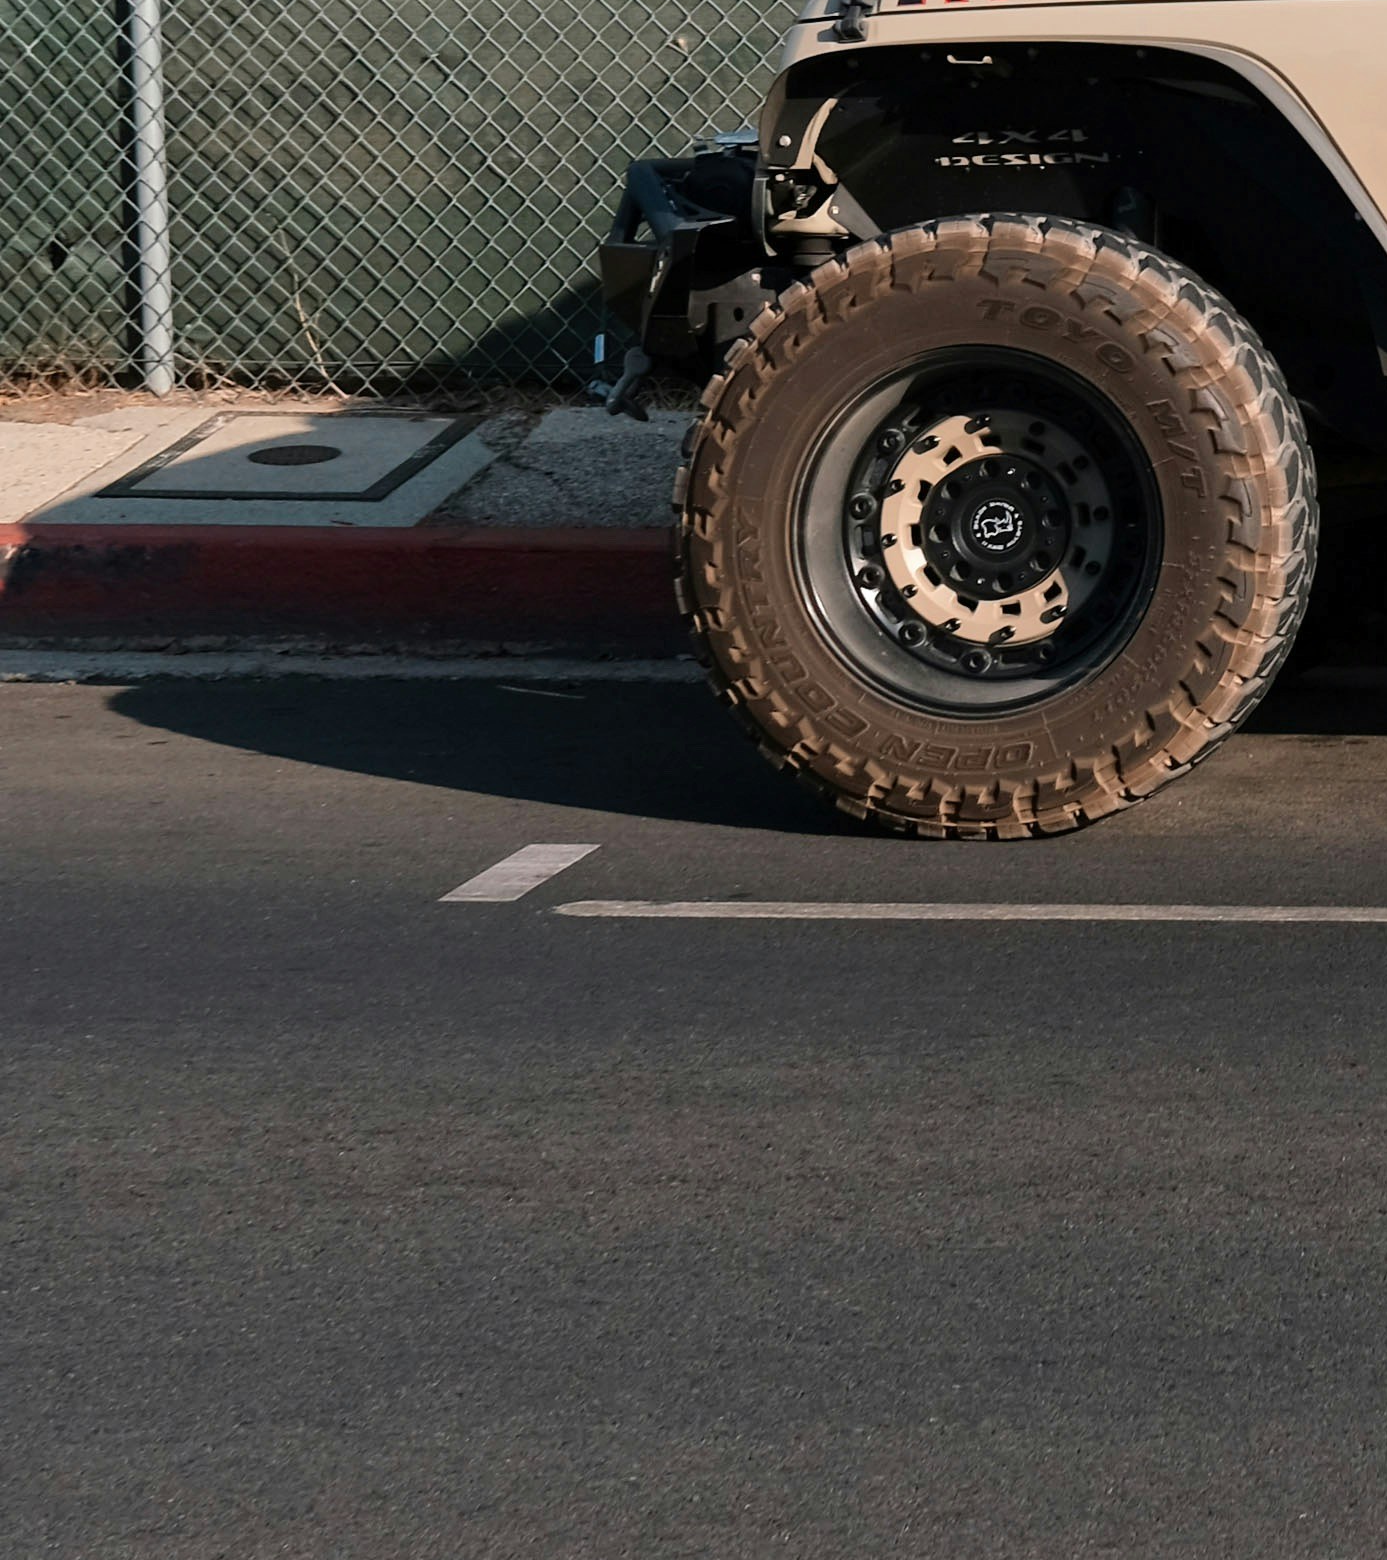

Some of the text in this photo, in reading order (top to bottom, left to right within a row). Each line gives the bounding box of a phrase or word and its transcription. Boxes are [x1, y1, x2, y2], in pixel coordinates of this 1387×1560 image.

[940, 152, 1110, 167] DESIGN
[976, 299, 1136, 374] TOYO
[1146, 399, 1208, 498] M/T
[736, 502, 1034, 772] OPEN COUNTRY
